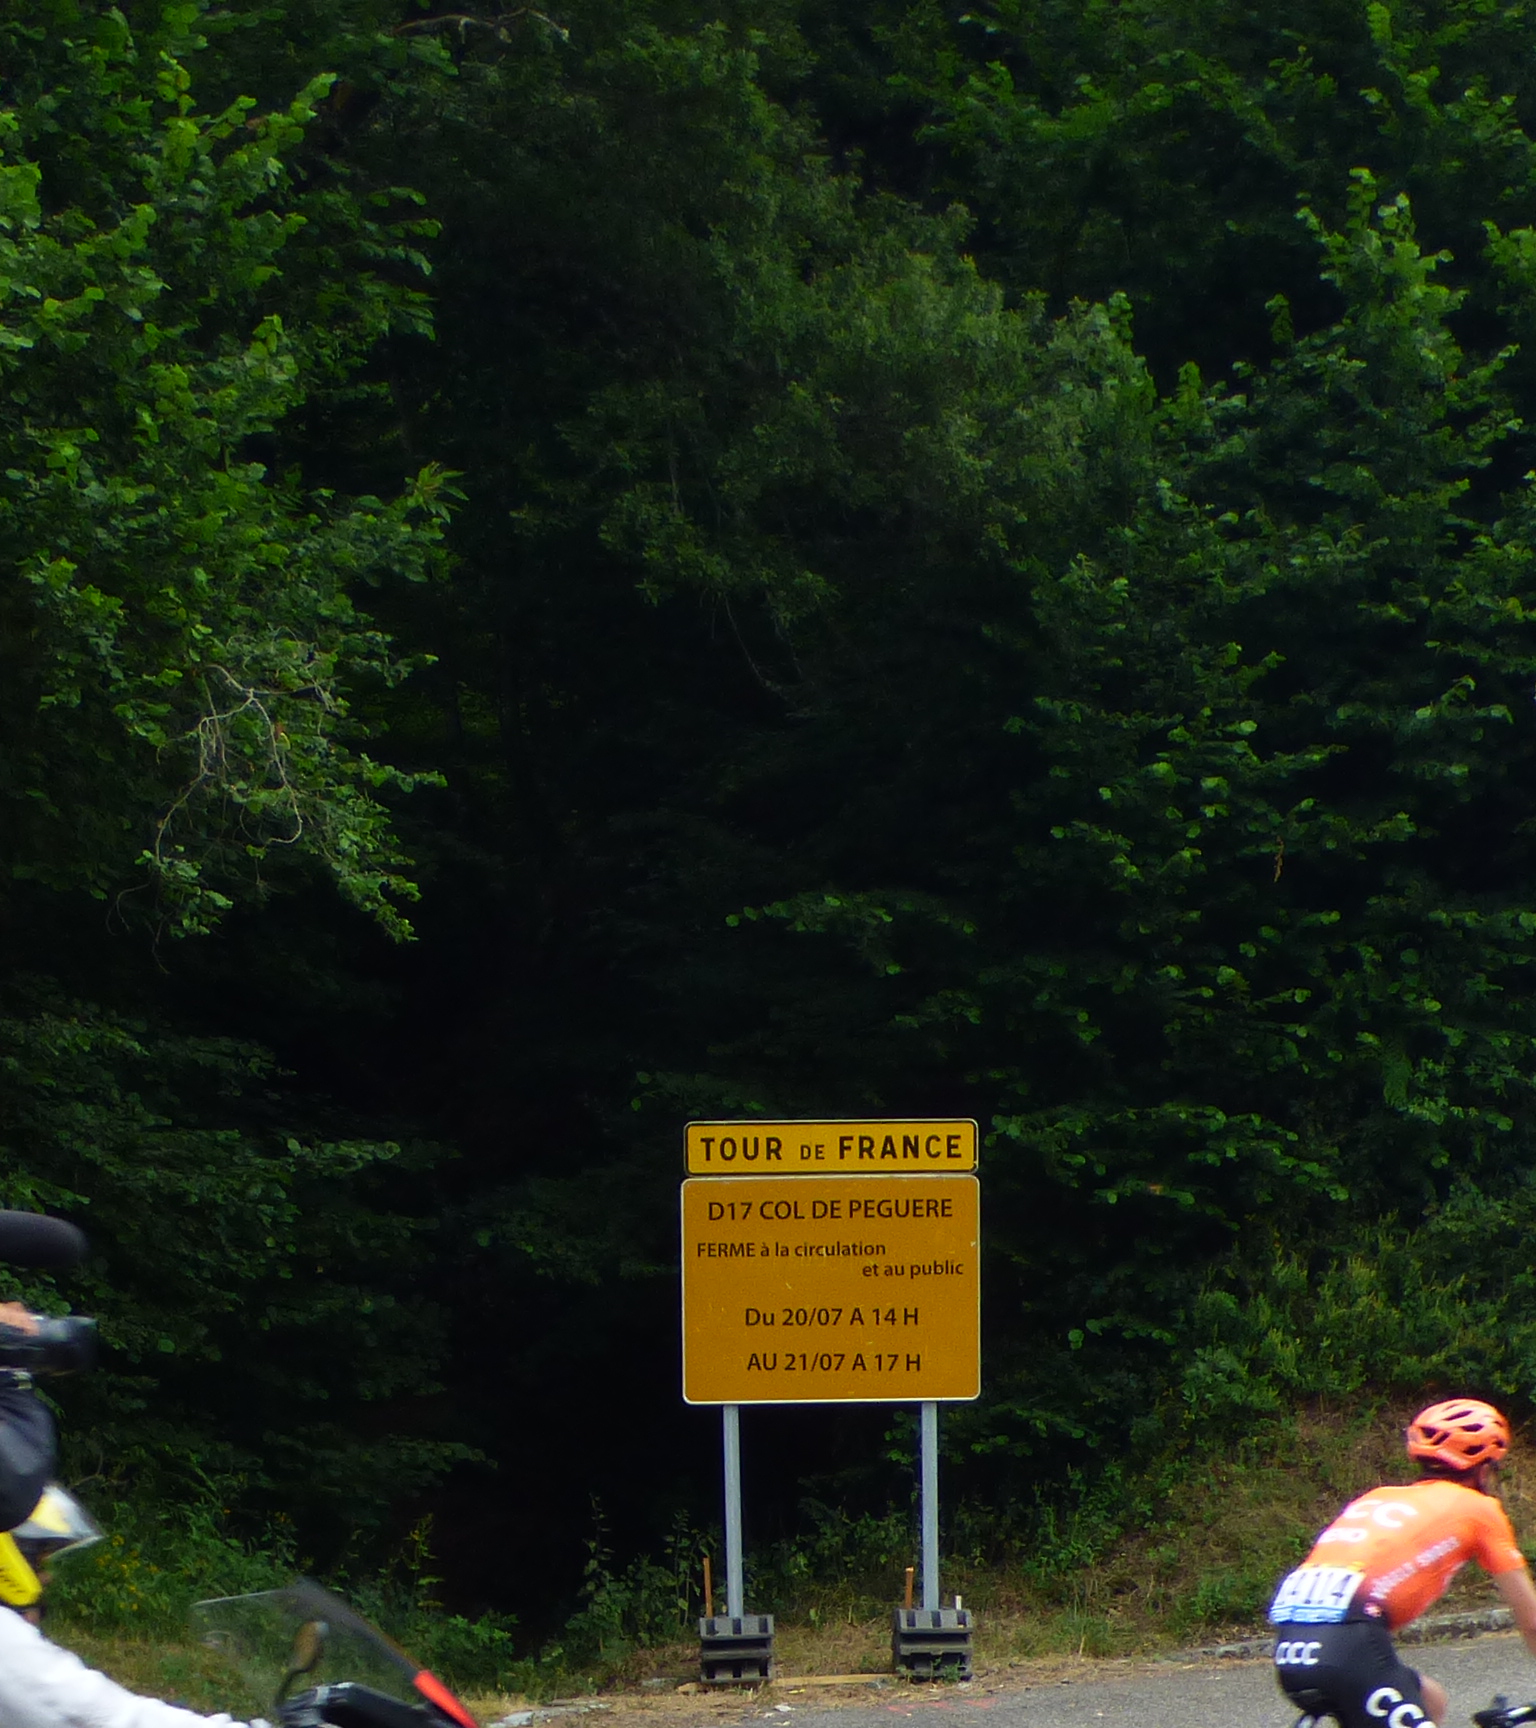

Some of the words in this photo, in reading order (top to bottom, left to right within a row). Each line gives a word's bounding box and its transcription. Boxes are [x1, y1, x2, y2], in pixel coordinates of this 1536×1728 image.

[700, 1137, 783, 1161] TOUR
[800, 1145, 825, 1160] DE
[839, 1134, 962, 1160] FRANCE
[708, 1202, 752, 1221] D17
[760, 1201, 805, 1220] COL
[813, 1200, 842, 1219] DE
[849, 1199, 952, 1219] PEGUERE
[697, 1243, 756, 1257] FERME
[760, 1242, 770, 1257] à
[775, 1242, 790, 1257] la
[794, 1241, 886, 1257] circulation
[862, 1264, 879, 1277] et
[884, 1264, 905, 1277] au
[910, 1260, 964, 1279] public
[745, 1308, 775, 1326] Du
[782, 1308, 843, 1327] 20/07
[850, 1308, 864, 1325] A
[872, 1308, 897, 1325] 14
[904, 1308, 919, 1325] H
[747, 1354, 777, 1372] AU
[784, 1353, 845, 1372] 21/07
[852, 1354, 867, 1371] A
[874, 1353, 898, 1371] 17
[906, 1354, 921, 1371] H
[1275, 1641, 1322, 1665] CCC
